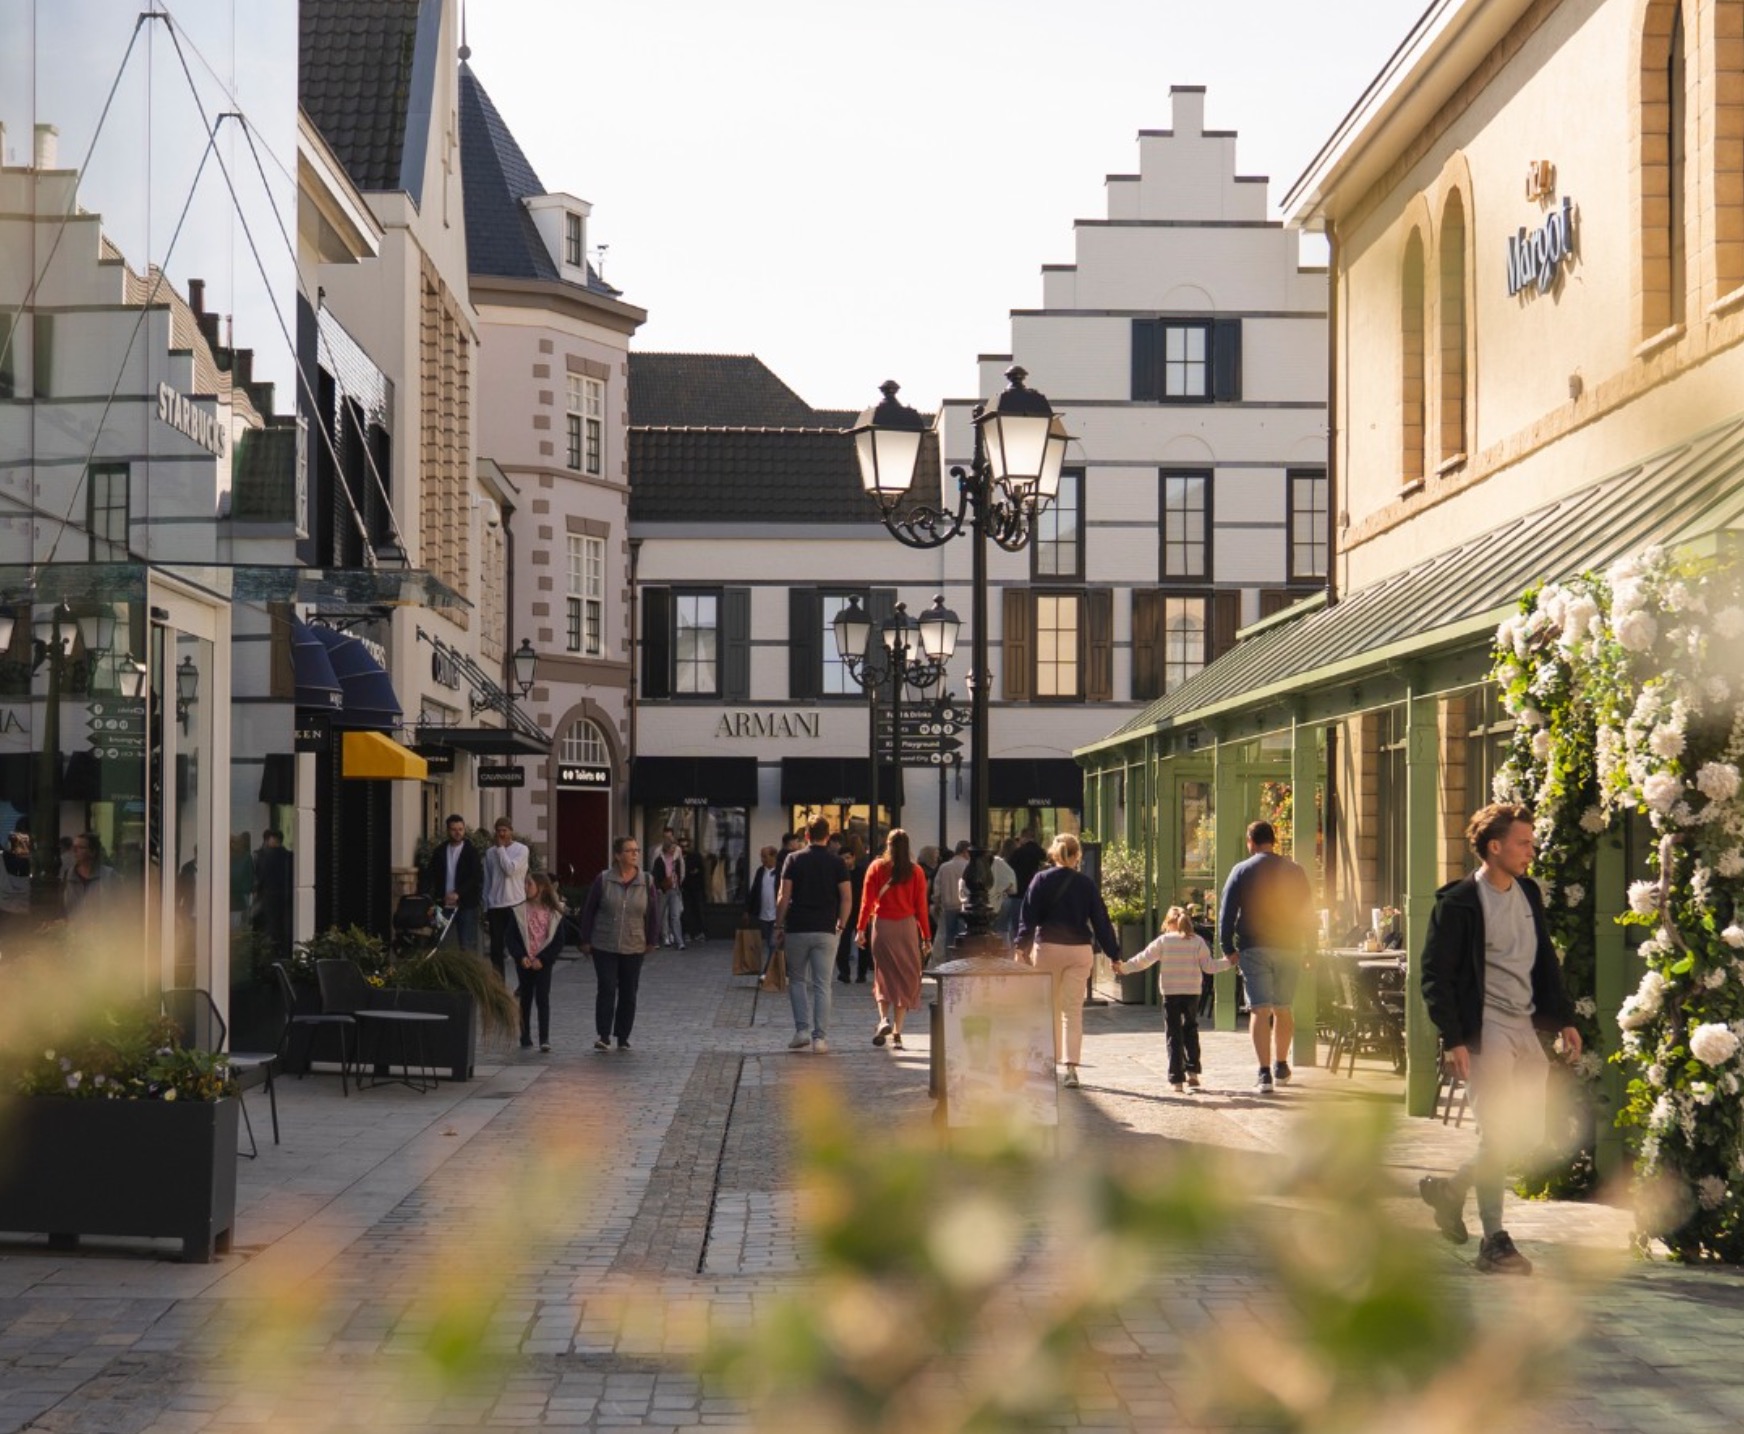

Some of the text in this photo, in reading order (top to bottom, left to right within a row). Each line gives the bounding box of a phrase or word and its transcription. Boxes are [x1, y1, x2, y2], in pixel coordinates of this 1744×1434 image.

[1506, 196, 1573, 295] Margot
[157, 381, 226, 458] STARBUCKS
[910, 711, 932, 719] Drinks
[714, 712, 820, 738] ARMANI
[901, 740, 940, 749] Playground
[574, 769, 595, 781] Toilets
